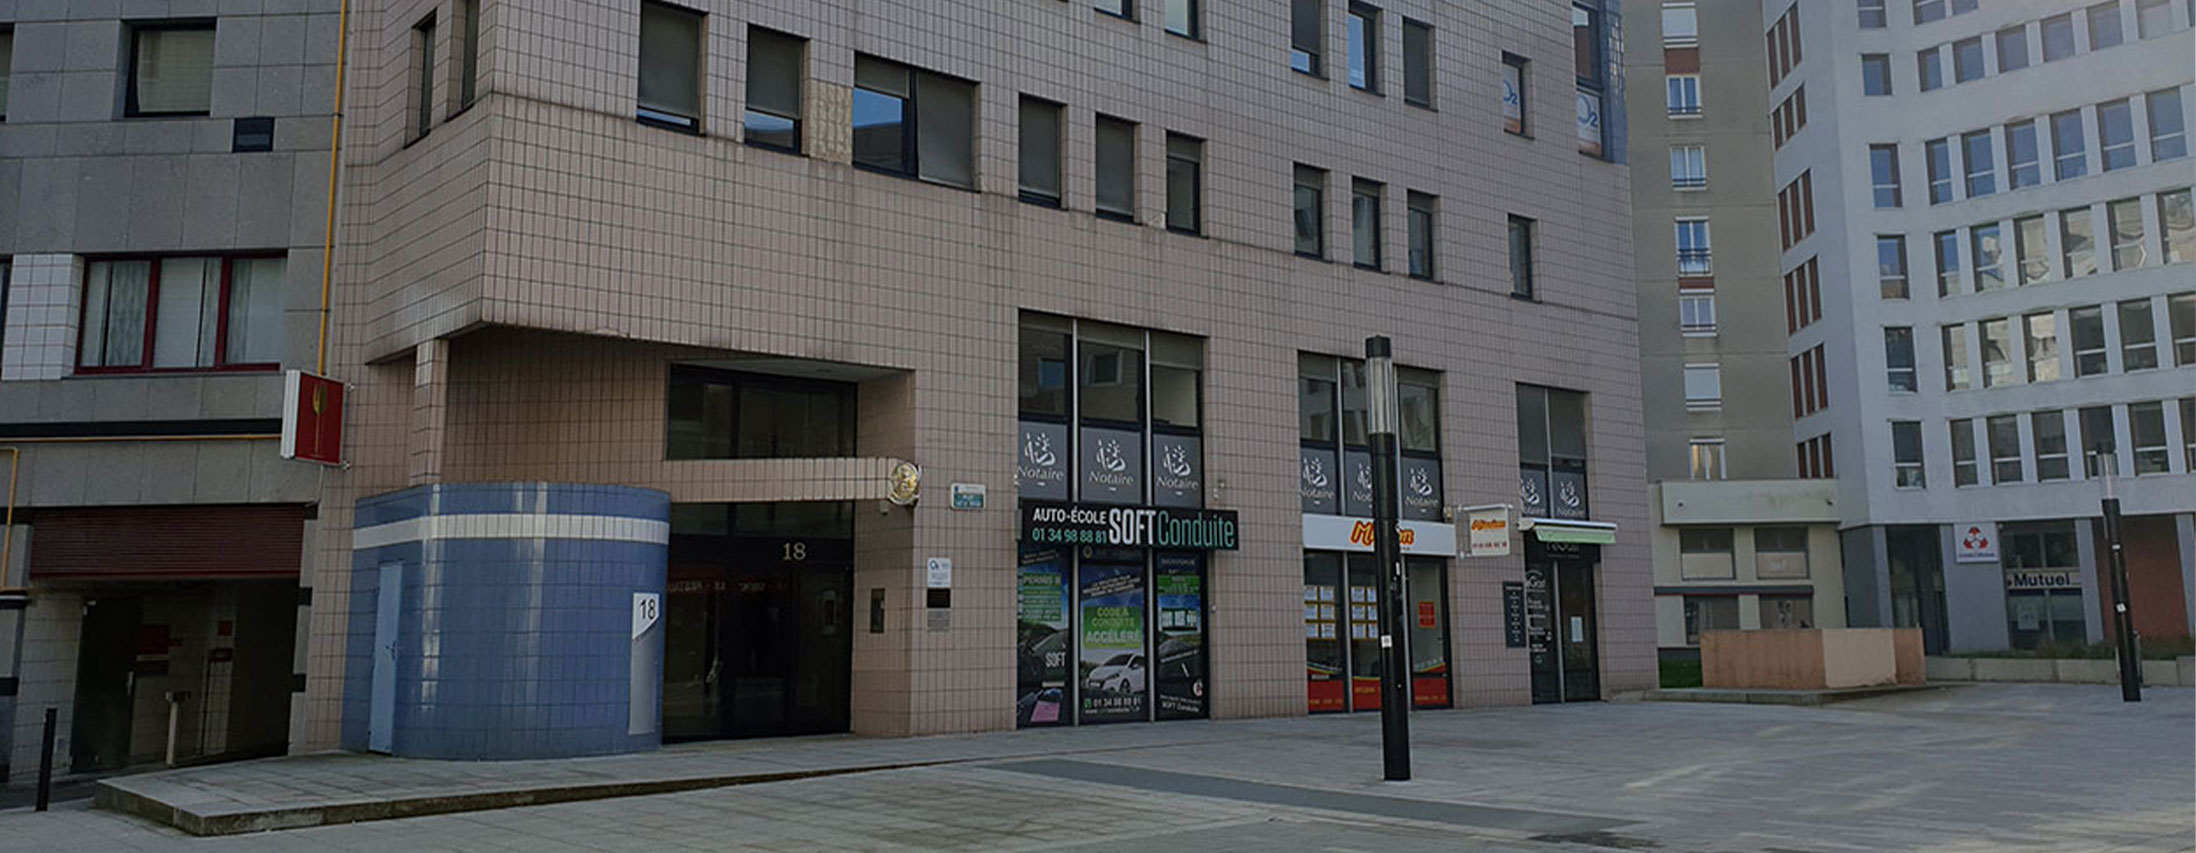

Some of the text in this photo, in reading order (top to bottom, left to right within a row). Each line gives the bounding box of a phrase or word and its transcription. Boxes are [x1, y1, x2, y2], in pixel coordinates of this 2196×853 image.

[1017, 465, 1065, 481] Notaire
[1088, 470, 1134, 486] Notaire
[1156, 476, 1199, 490] Notaire
[1032, 506, 1107, 525] AUTO-ÉCOLE
[1032, 527, 1045, 541] 01
[1047, 527, 1062, 541] 34
[1080, 529, 1093, 543] 88
[1095, 530, 1107, 544] 81
[783, 542, 807, 561] 18
[2013, 571, 2070, 587] Mutuel
[639, 599, 656, 620] 18
